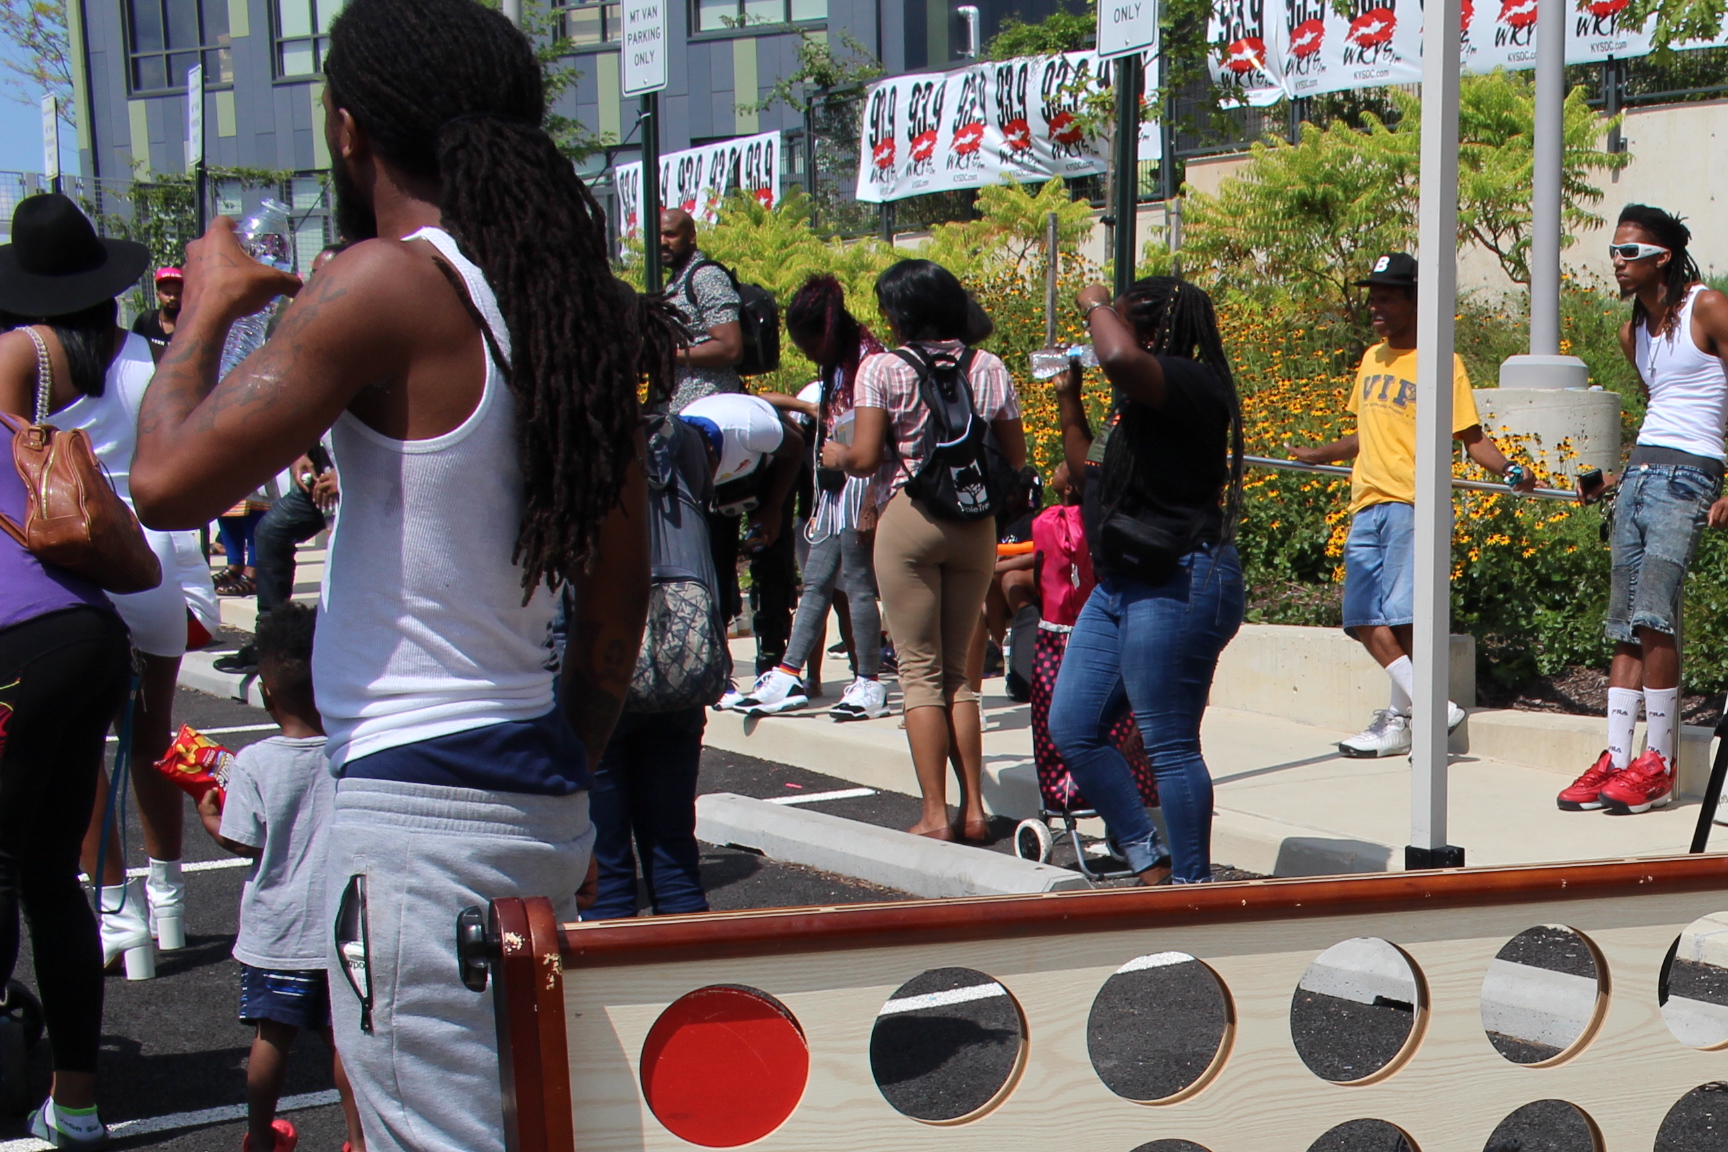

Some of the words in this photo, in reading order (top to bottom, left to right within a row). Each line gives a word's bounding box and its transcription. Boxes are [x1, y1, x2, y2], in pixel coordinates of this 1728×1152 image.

[629, 9, 640, 24] MT
[641, 5, 658, 20] VAN
[1113, 2, 1142, 24] ONLY
[627, 26, 661, 46] PARKING
[1495, 22, 1538, 47] WKY
[1590, 41, 1627, 53] KYSDC.com
[634, 50, 655, 67] ONLY
[1353, 68, 1390, 80] KYSDC.com
[995, 62, 1028, 131] 93.9
[907, 80, 949, 144] 93.9
[1373, 255, 1391, 273] B
[1611, 708, 1629, 717] FILA
